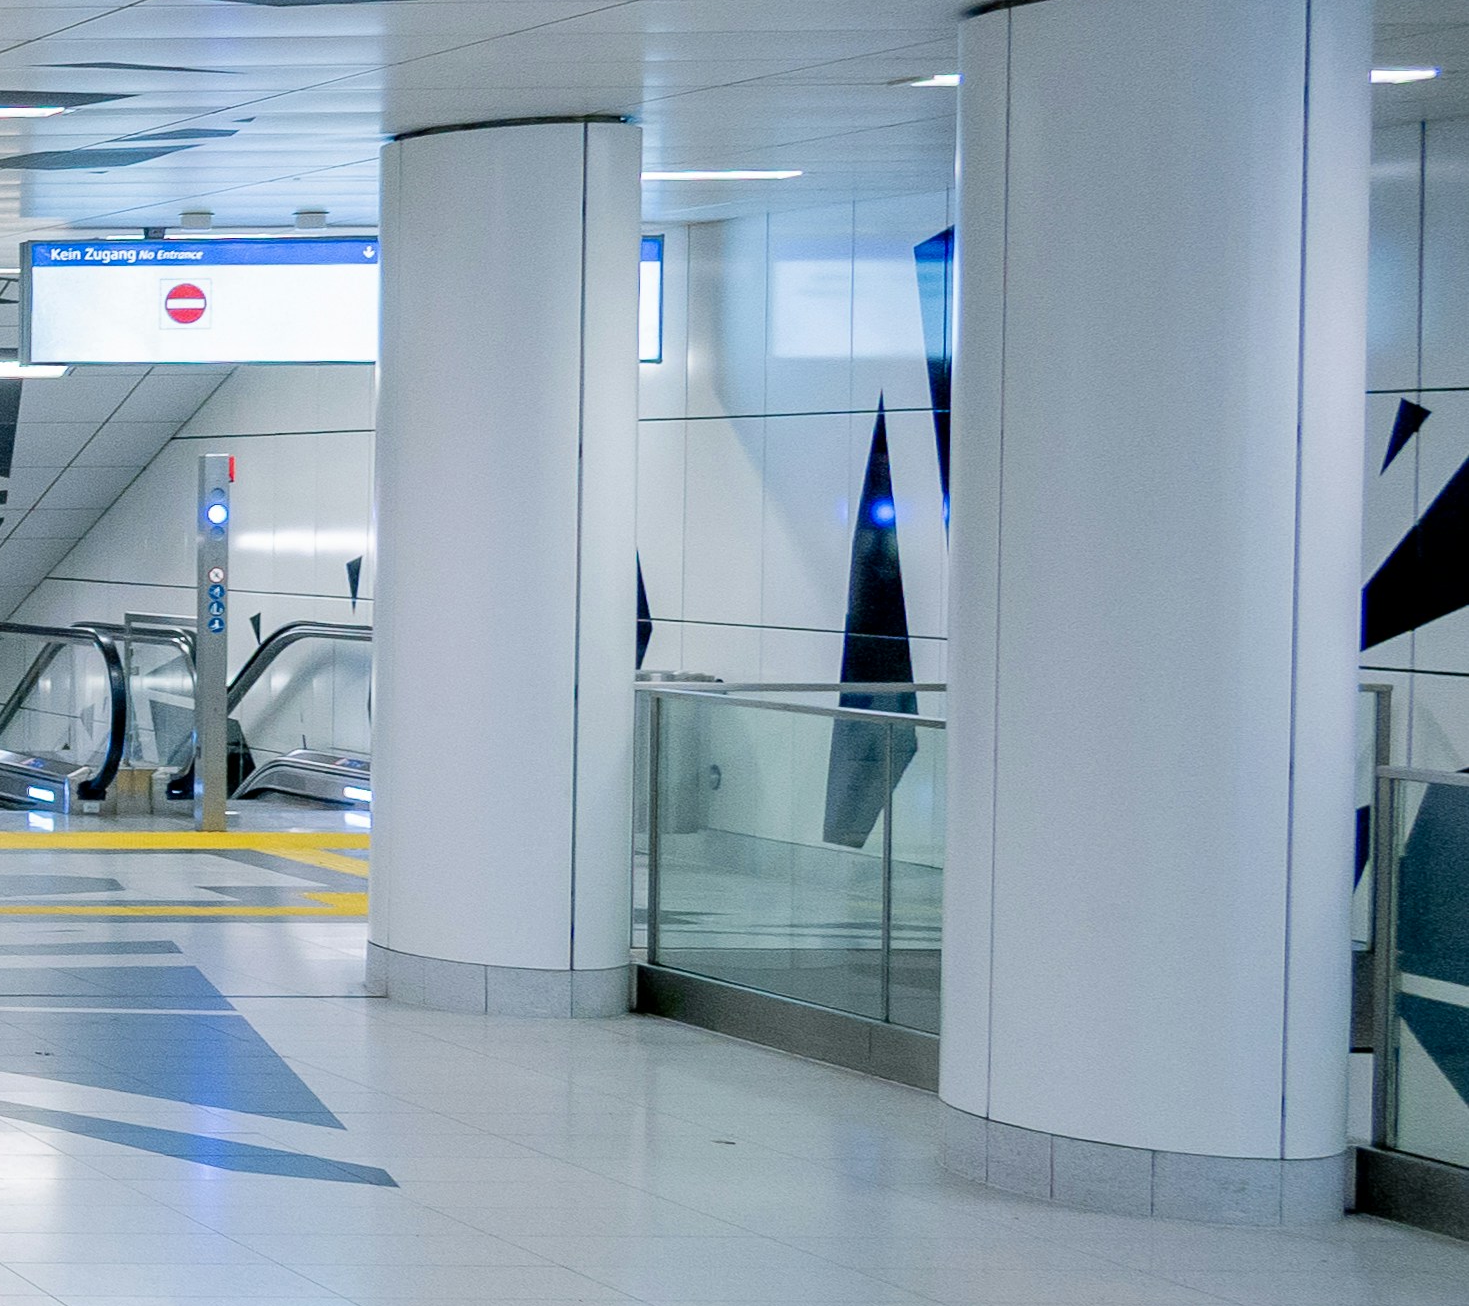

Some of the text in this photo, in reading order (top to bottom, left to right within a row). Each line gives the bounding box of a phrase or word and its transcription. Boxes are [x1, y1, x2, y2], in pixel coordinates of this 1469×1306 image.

[51, 248, 203, 263] Kein Zugang No Entrance
